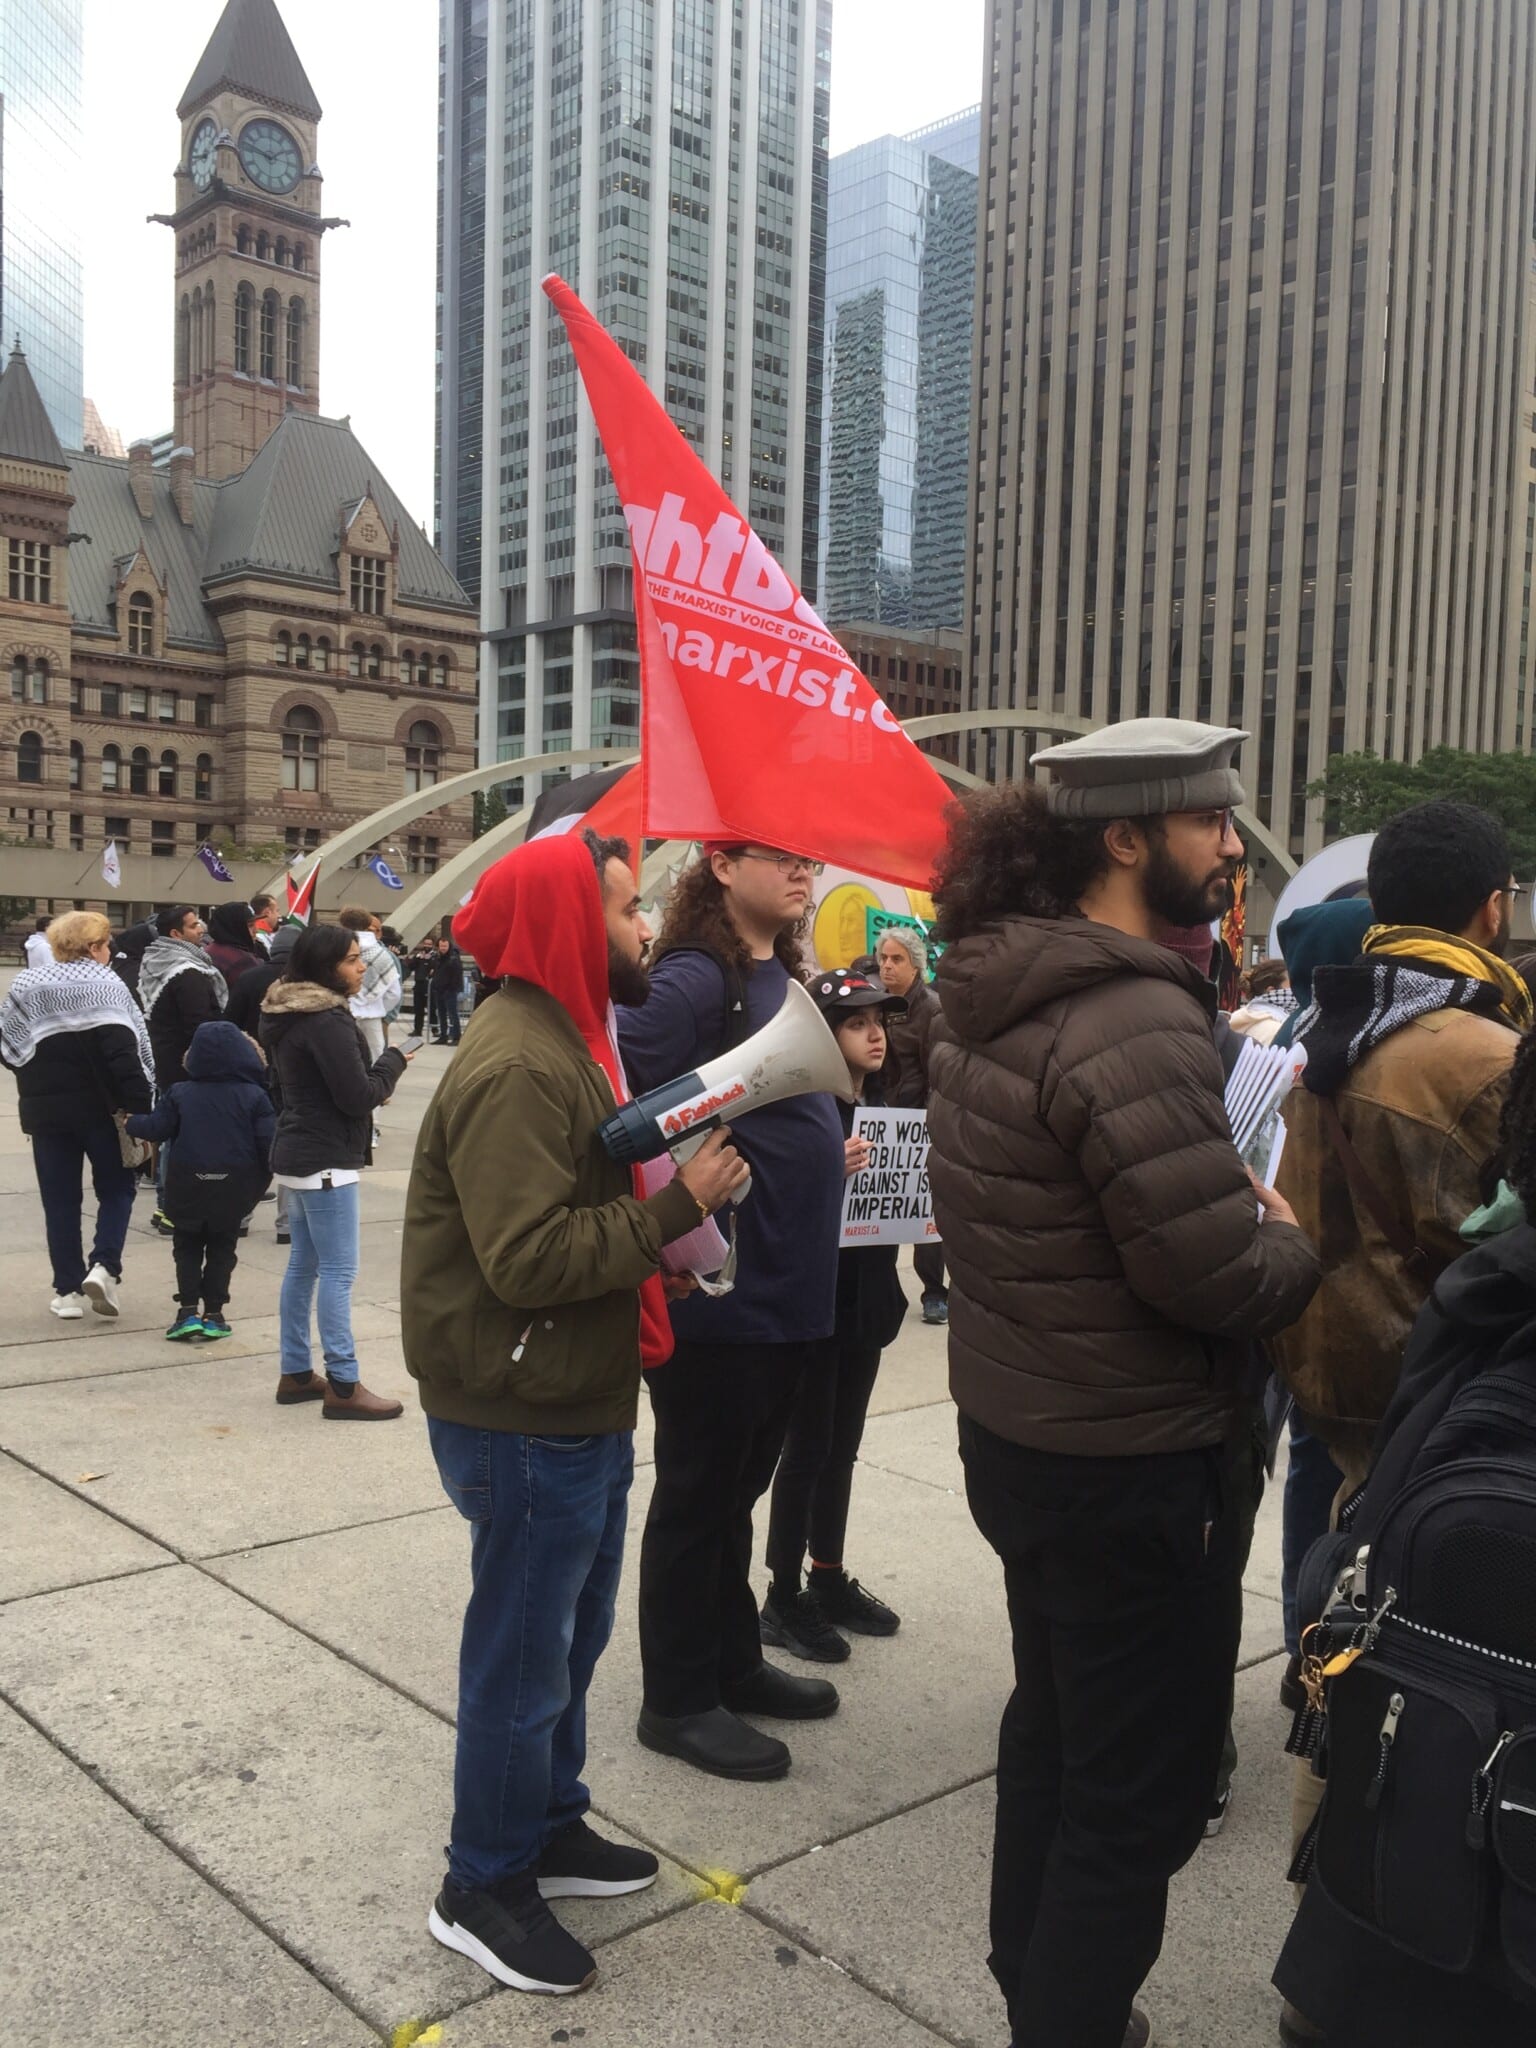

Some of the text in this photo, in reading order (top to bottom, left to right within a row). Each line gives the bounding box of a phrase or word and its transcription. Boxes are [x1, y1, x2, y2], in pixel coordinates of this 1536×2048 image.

[622, 491, 836, 640] htb
[647, 580, 850, 661] THE MARXIST VOICE OF LABO
[859, 1120, 931, 1145] FOR WOR
[862, 1146, 928, 1169] OBILIZ
[850, 1171, 931, 1196] AGAINST IS
